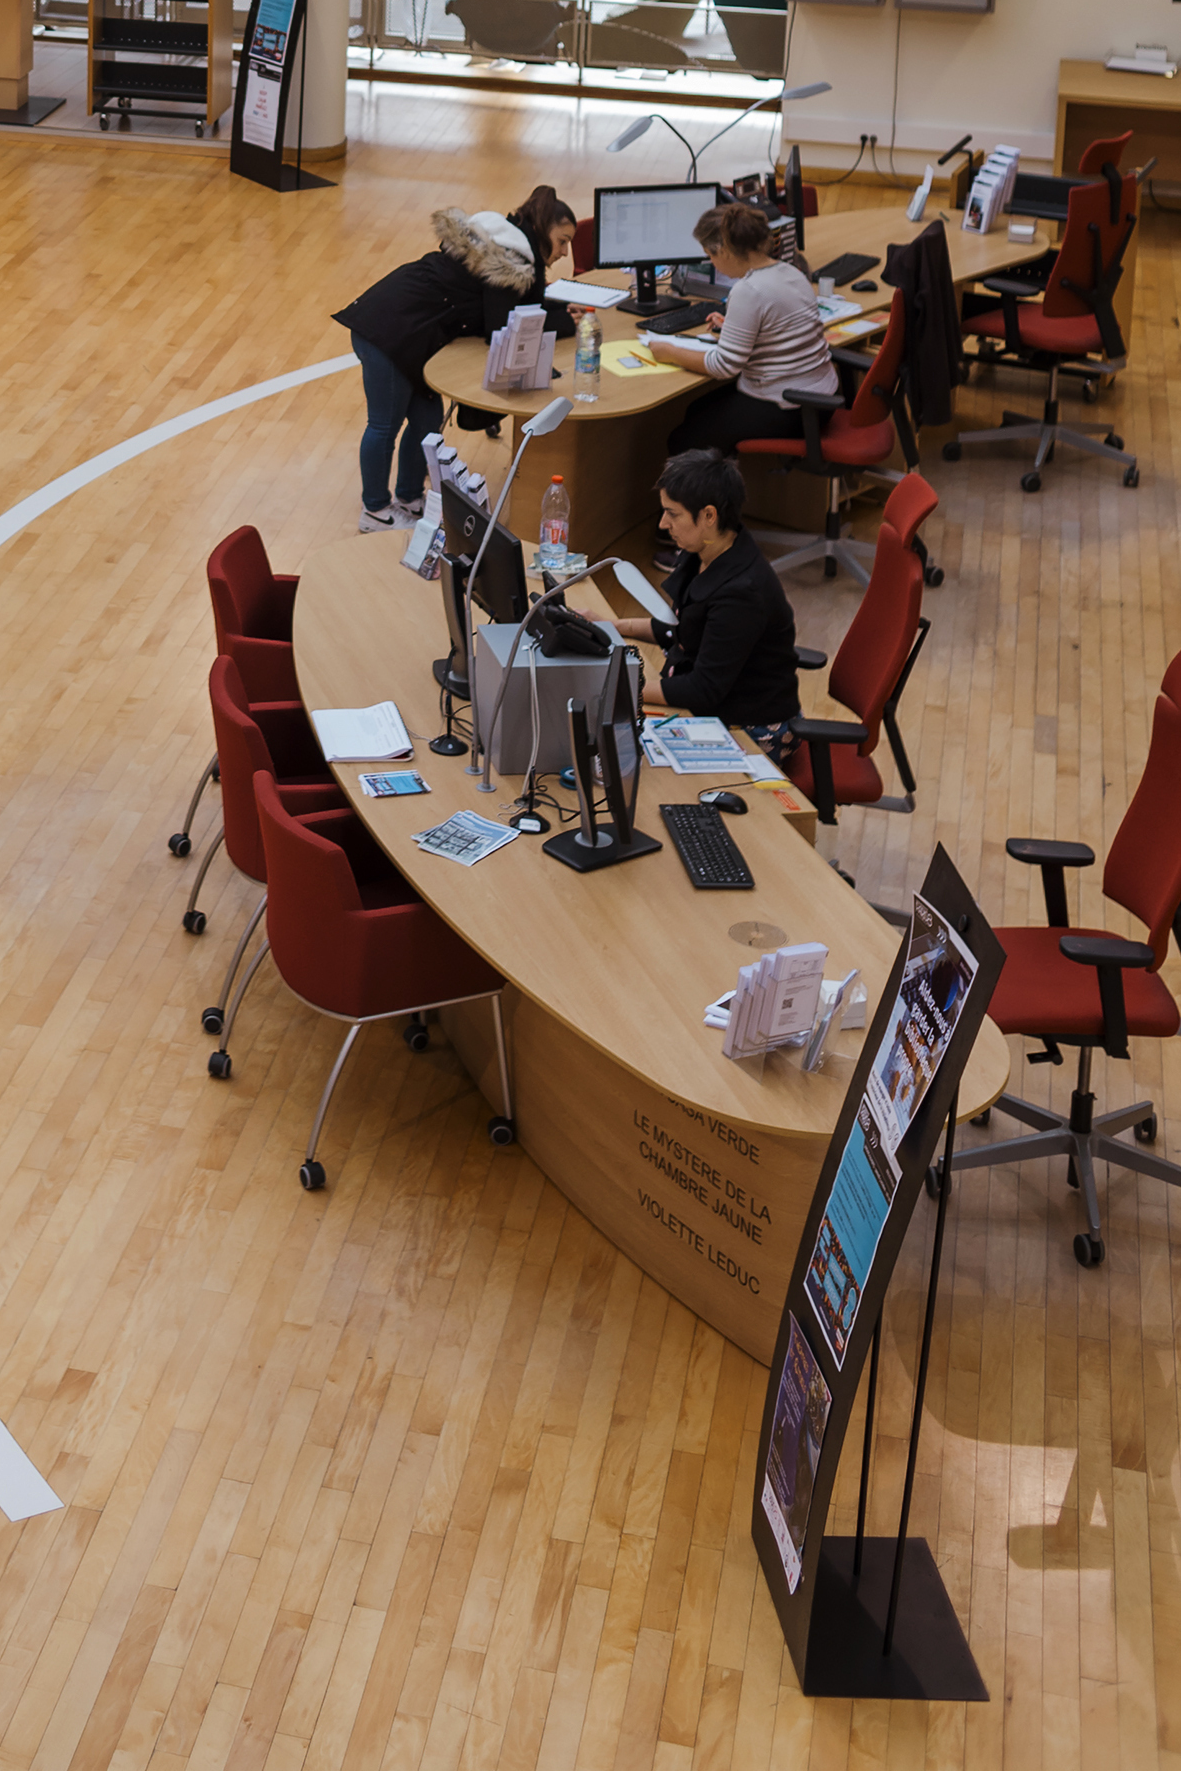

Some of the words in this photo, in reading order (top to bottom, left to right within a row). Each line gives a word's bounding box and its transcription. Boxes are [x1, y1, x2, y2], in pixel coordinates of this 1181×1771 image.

[911, 1002, 930, 1036] garder
[927, 1027, 935, 1047] la
[918, 979, 949, 1034] Aidez-nous
[634, 1109, 650, 1135] LE
[653, 1125, 721, 1190] MYSTERE
[725, 1179, 746, 1209] DE
[750, 1197, 772, 1225] LA
[707, 1116, 760, 1165] VERDE
[639, 1140, 708, 1206] CHAMBRE
[712, 1198, 763, 1246] JAUNE
[637, 1188, 704, 1255] VIOLETTE
[708, 1244, 760, 1295] LEDUC
